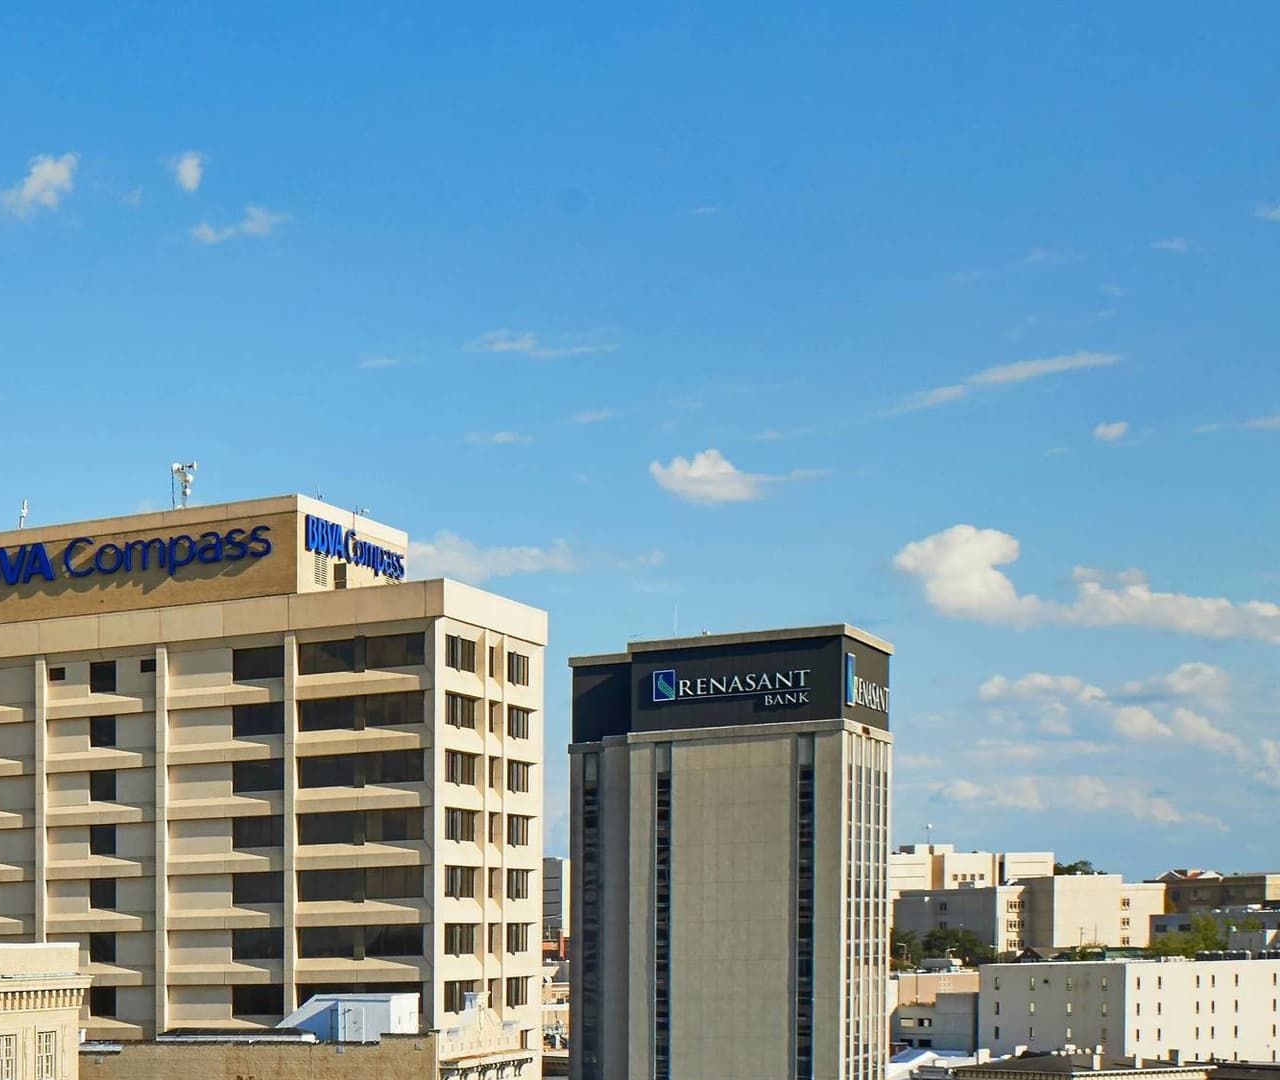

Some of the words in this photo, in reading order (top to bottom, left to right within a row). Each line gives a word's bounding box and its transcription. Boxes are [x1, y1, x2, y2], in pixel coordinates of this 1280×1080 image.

[64, 525, 272, 578] Compass
[305, 514, 344, 561] BBVA
[344, 528, 405, 580] Compass
[679, 670, 811, 696] RENASANT
[765, 692, 809, 706] BANK
[853, 676, 889, 713] RENASANT
